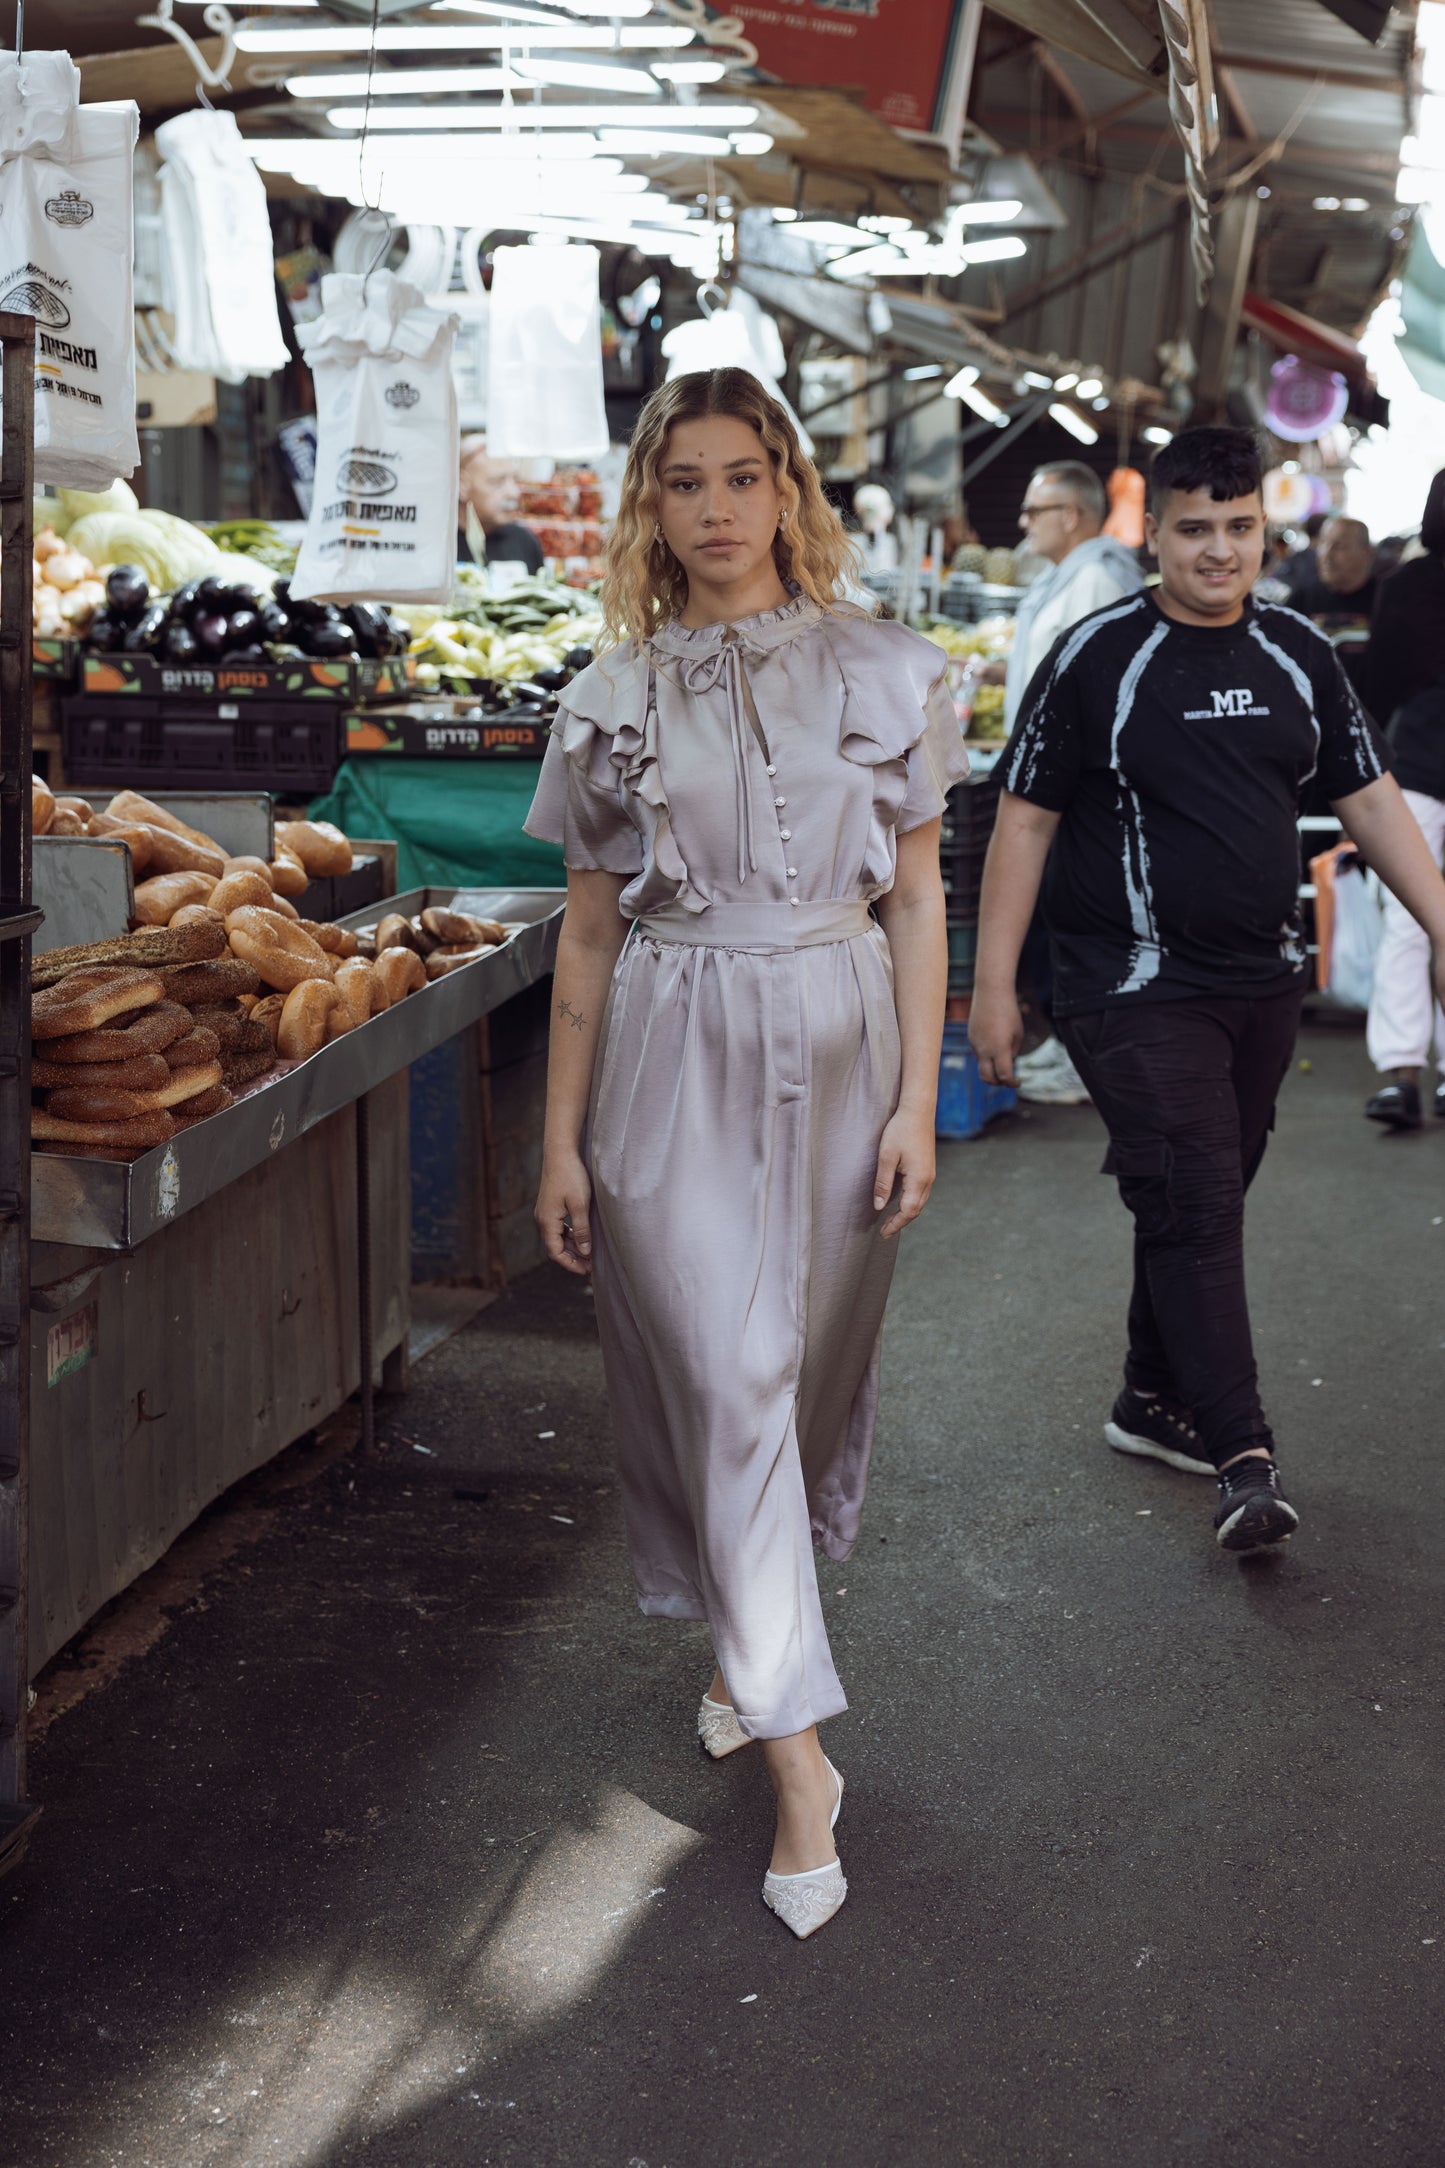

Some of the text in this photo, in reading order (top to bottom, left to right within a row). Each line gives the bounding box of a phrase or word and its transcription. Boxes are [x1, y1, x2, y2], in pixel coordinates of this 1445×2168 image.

[40, 332, 98, 371] מאפיית
[360, 502, 417, 523] מאפיית
[161, 669, 269, 691] בוסתן הדרום
[1210, 688, 1253, 717] MP
[425, 728, 535, 748] בוסתן הדרום
